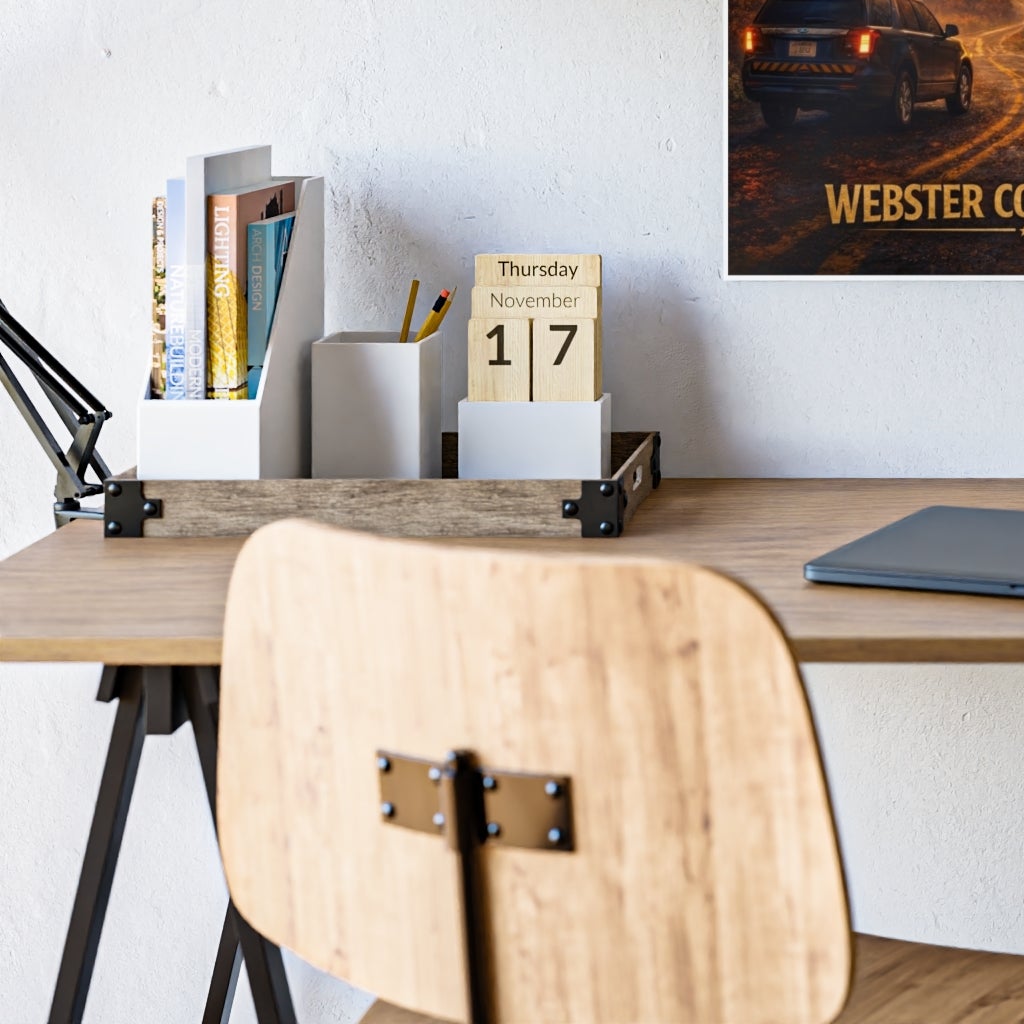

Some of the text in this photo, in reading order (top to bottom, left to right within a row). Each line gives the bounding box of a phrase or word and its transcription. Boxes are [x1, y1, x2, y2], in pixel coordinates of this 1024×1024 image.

[824, 183, 985, 225] WEBSTER
[214, 206, 230, 298] LIGHTING
[251, 229, 263, 311] ARCH DESIGN
[497, 260, 579, 280] Thursday
[490, 292, 581, 309] November
